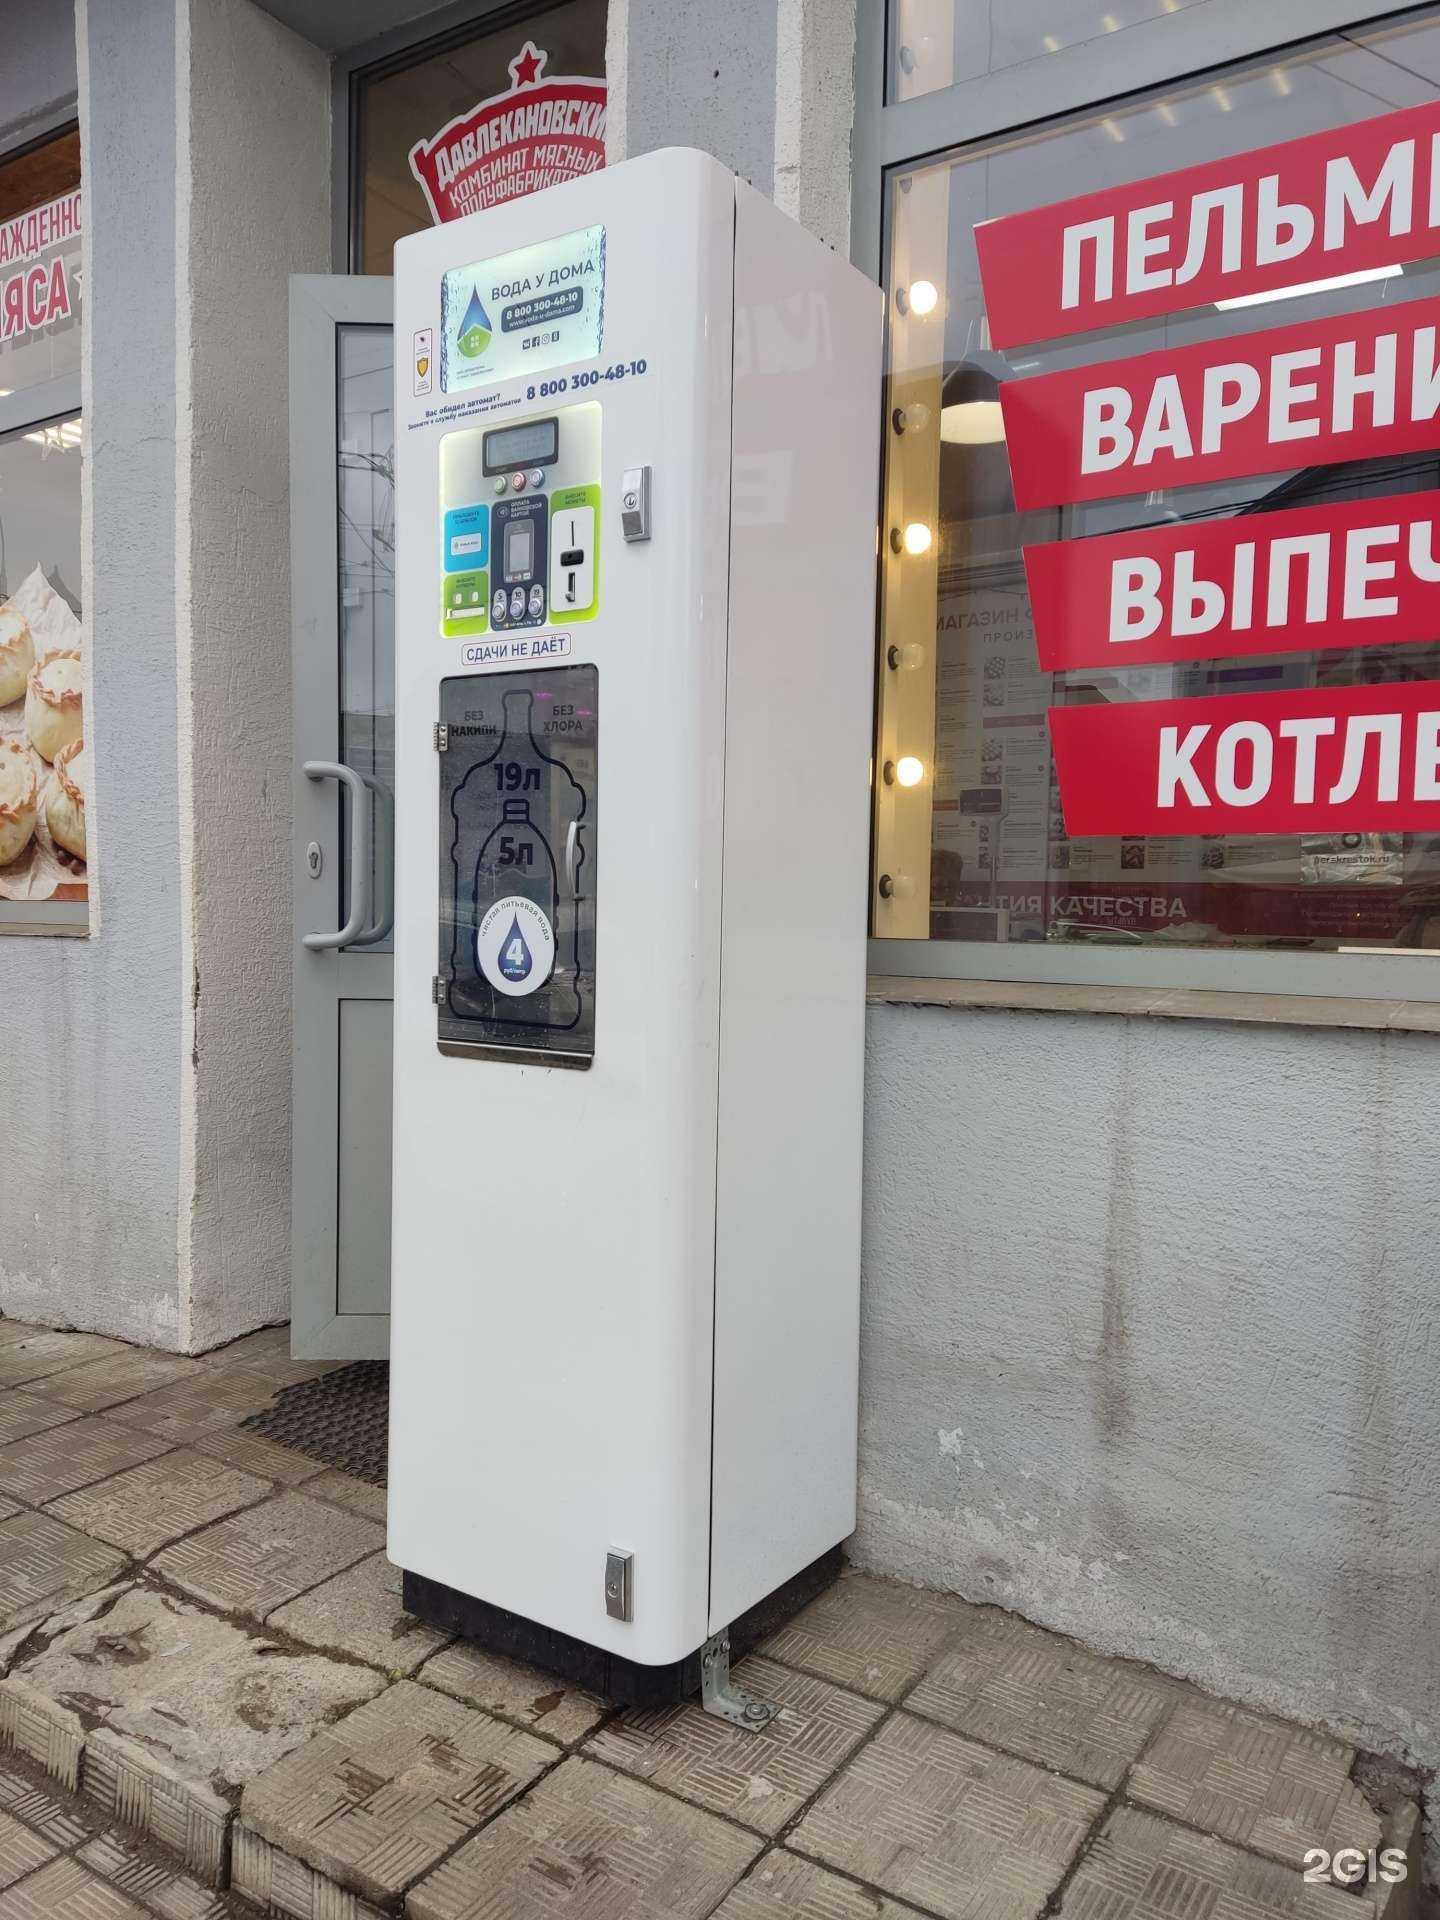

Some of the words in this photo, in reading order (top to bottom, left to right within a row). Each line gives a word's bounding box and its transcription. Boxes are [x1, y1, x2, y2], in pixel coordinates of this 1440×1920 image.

[450, 147, 529, 208] КОМБИНАТ
[533, 144, 603, 174] МЯСНЫХ
[491, 279, 531, 300] ВОДА
[535, 273, 545, 288] У
[548, 259, 594, 287] ДОМА
[506, 310, 513, 320] 8
[514, 305, 531, 318] 800
[533, 292, 578, 313] 300-48-10
[526, 386, 536, 400] 8
[539, 378, 567, 397] 800
[571, 359, 647, 389] 300-48-10
[466, 647, 508, 662] СДАЧИ
[511, 642, 528, 657] НЕ
[531, 636, 566, 656] ДАЁТ
[464, 710, 484, 721] БЕЗ
[552, 705, 574, 716] БЕЗ
[543, 720, 583, 733] ХЛОРА
[493, 762, 540, 791] 19л
[498, 837, 533, 865] 5л
[1051, 895, 1187, 918] КАЧЕСТВА
[506, 939, 524, 965] 4
